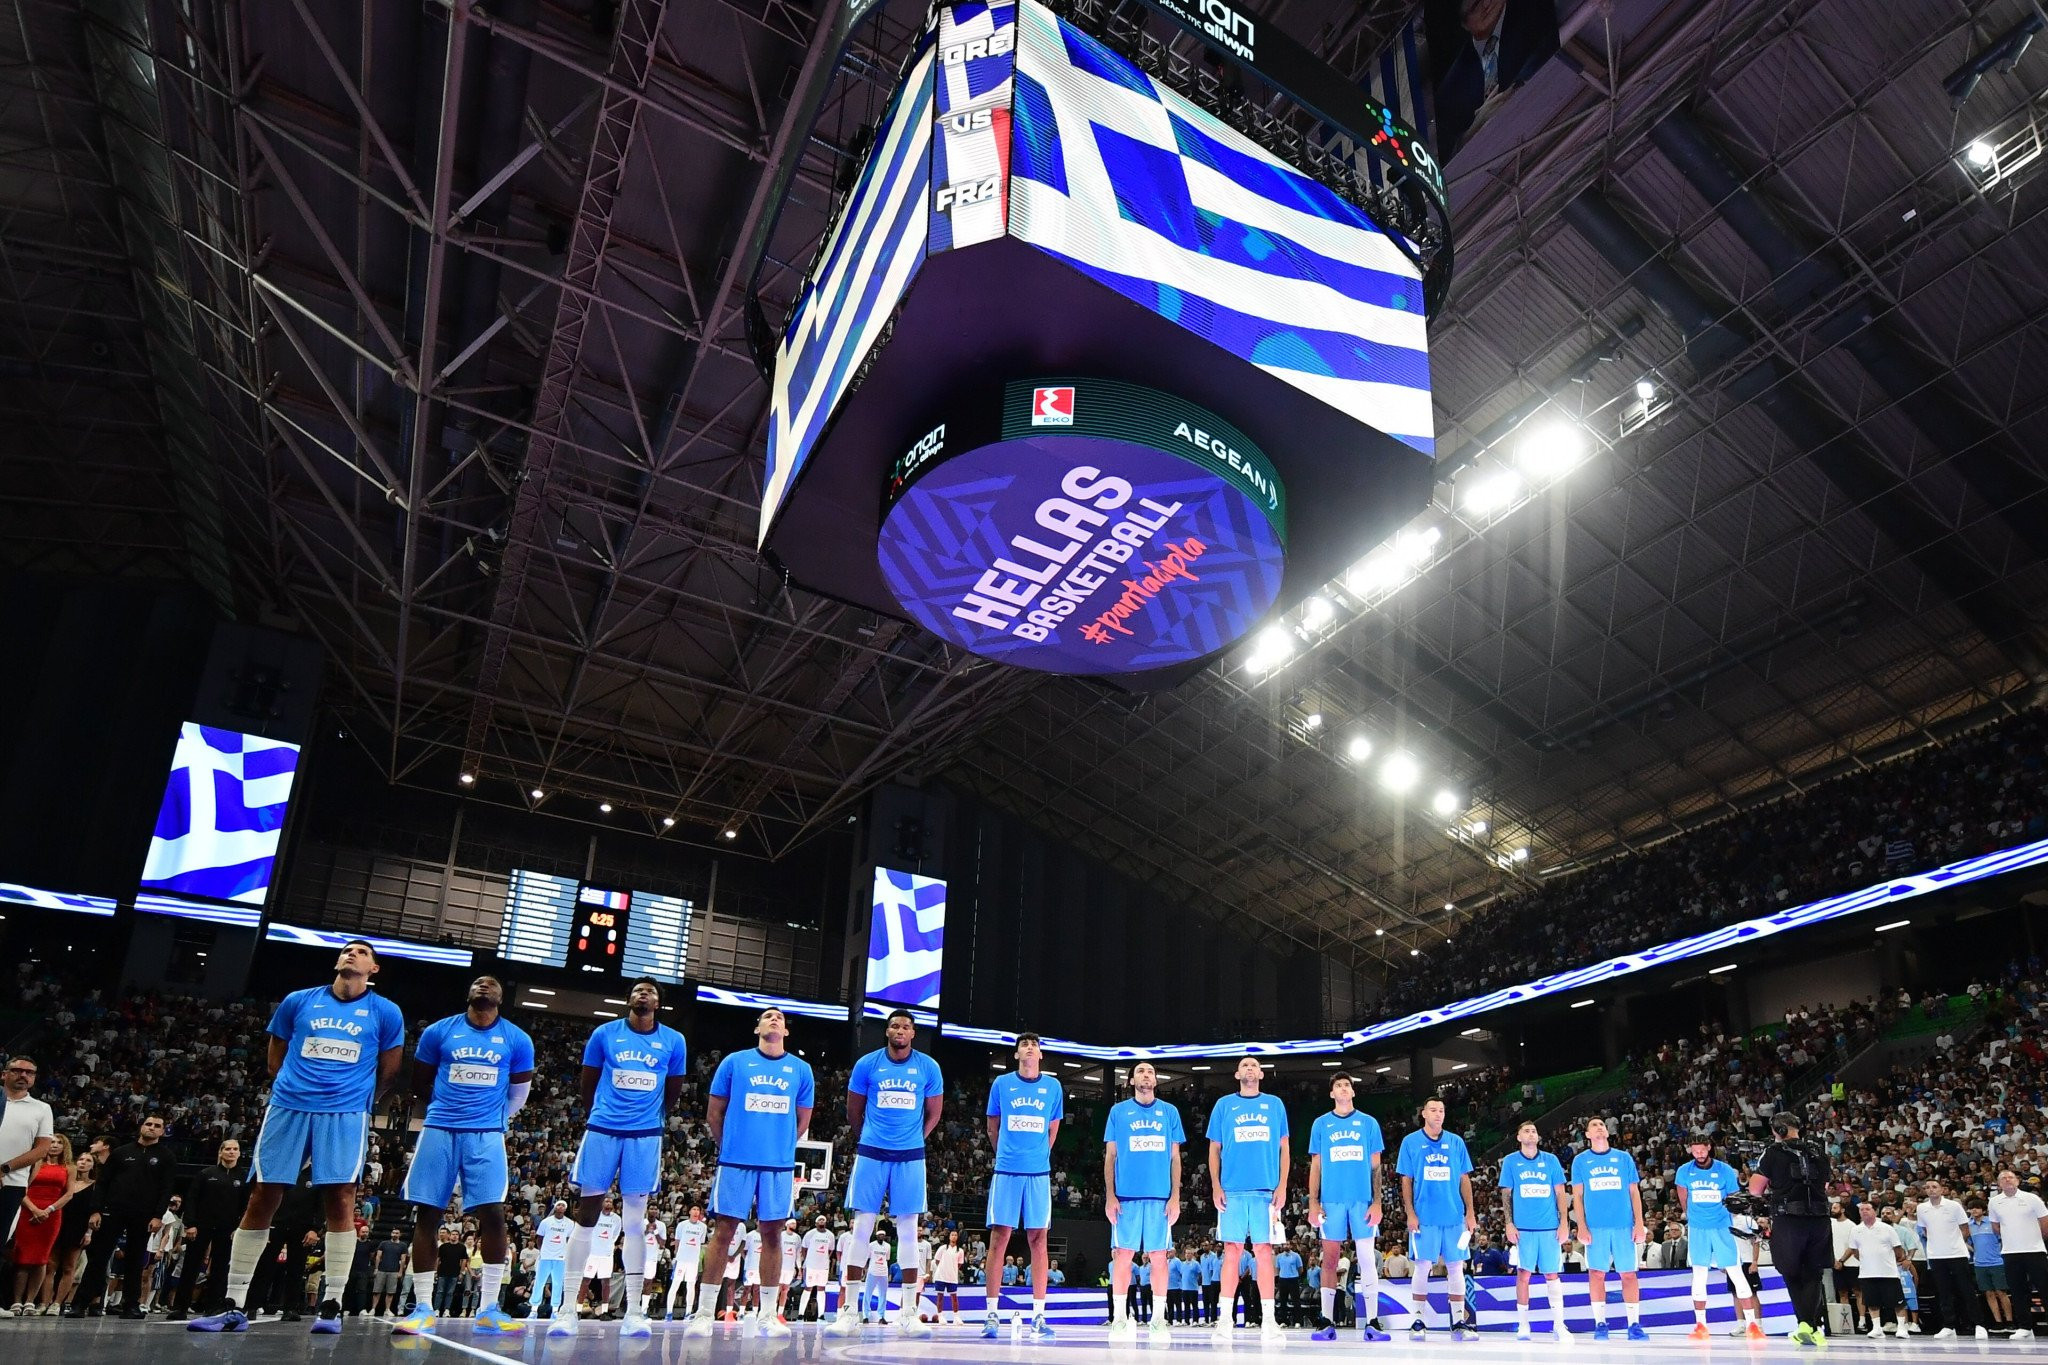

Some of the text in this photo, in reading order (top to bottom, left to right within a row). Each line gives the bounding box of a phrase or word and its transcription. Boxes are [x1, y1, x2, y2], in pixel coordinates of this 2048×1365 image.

[1203, 21, 1254, 62] allwyn
[944, 34, 1008, 67] GRE
[936, 176, 1001, 212] FRA
[1173, 422, 1266, 495] AEGEAN
[952, 465, 1134, 631] HELLAS
[1012, 497, 1184, 643] BASKETBALL
[589, 911, 615, 928] 4:25
[310, 1018, 362, 1036] HELLAS
[451, 1047, 502, 1064] HELLAS
[615, 1051, 658, 1068] HELLAS
[750, 1075, 789, 1091] HELLAS
[878, 1079, 917, 1092] HELLAS
[1010, 1097, 1045, 1111] HELLAS
[1129, 1120, 1163, 1132] HELLAS
[1235, 1113, 1269, 1125] HELLAS
[1329, 1130, 1361, 1143] HELLAS
[1519, 1171, 1547, 1181] HELLAS
[1590, 1166, 1618, 1177] HELLAS
[1690, 1180, 1719, 1191] HELLAS
